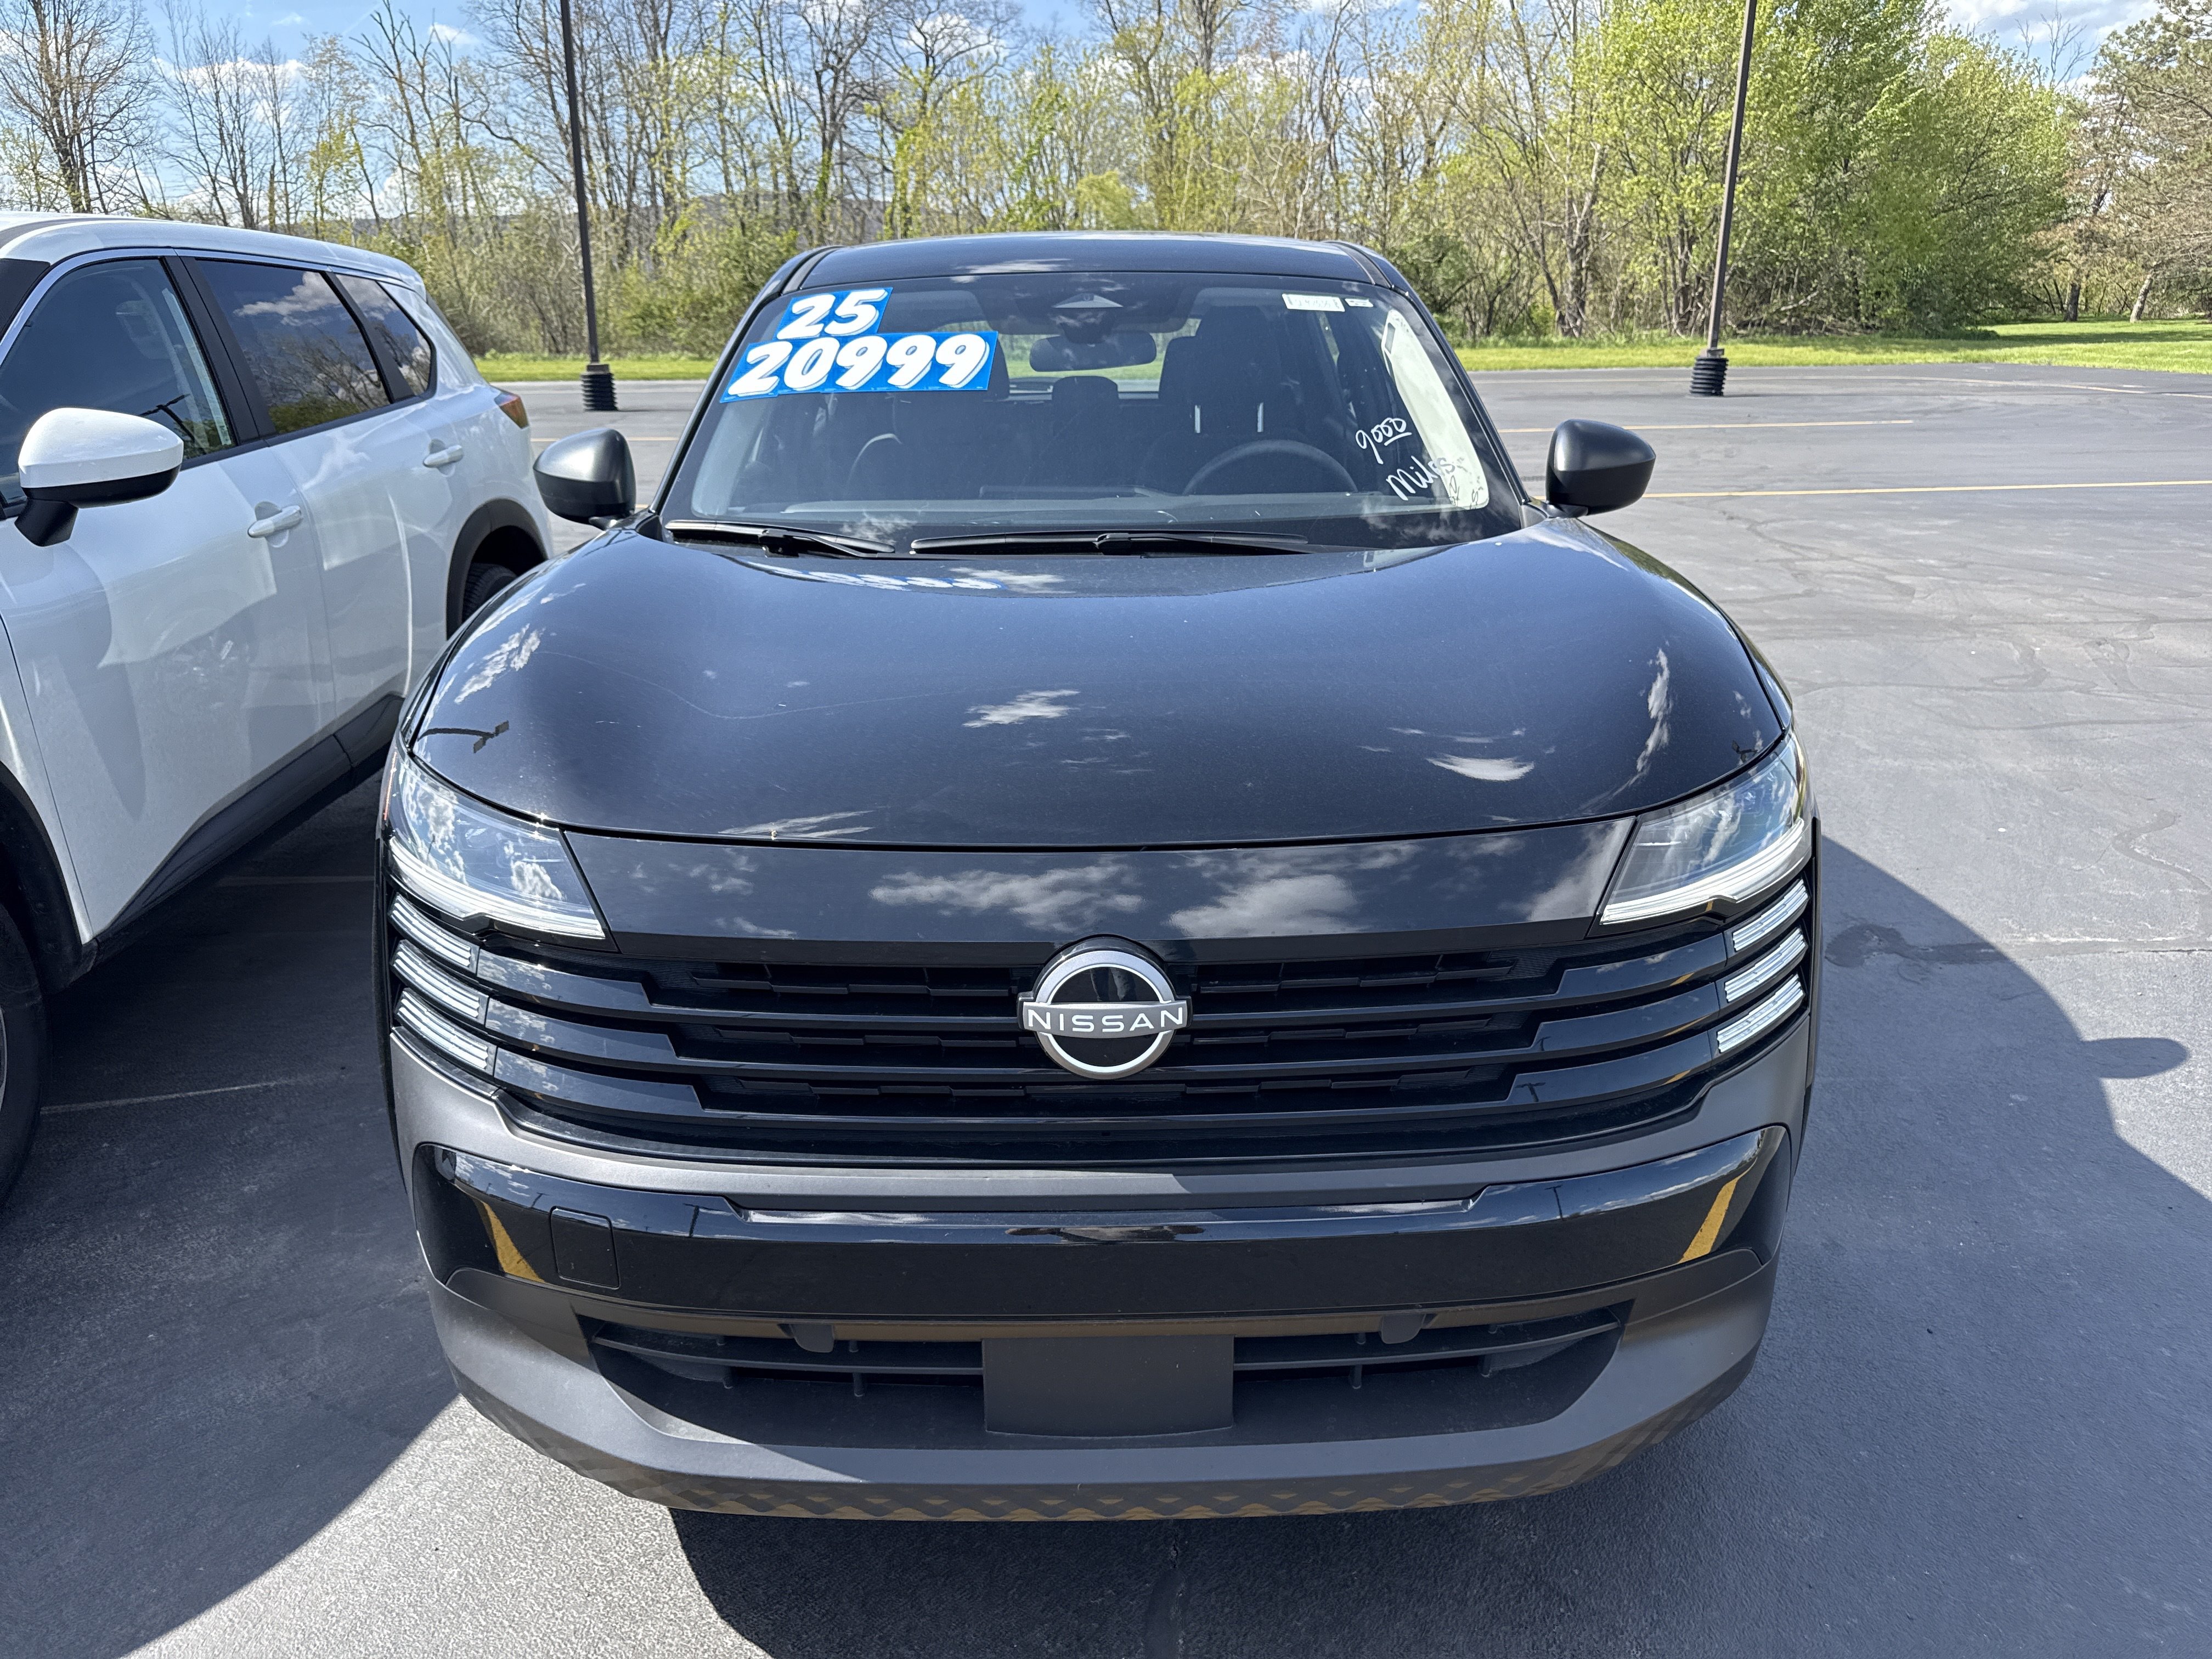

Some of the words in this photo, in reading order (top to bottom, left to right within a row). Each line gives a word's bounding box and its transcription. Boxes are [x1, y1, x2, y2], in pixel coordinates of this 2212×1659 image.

[777, 289, 889, 340] 25
[728, 334, 990, 397] 20999
[1028, 1007, 1183, 1032] NISSAN
